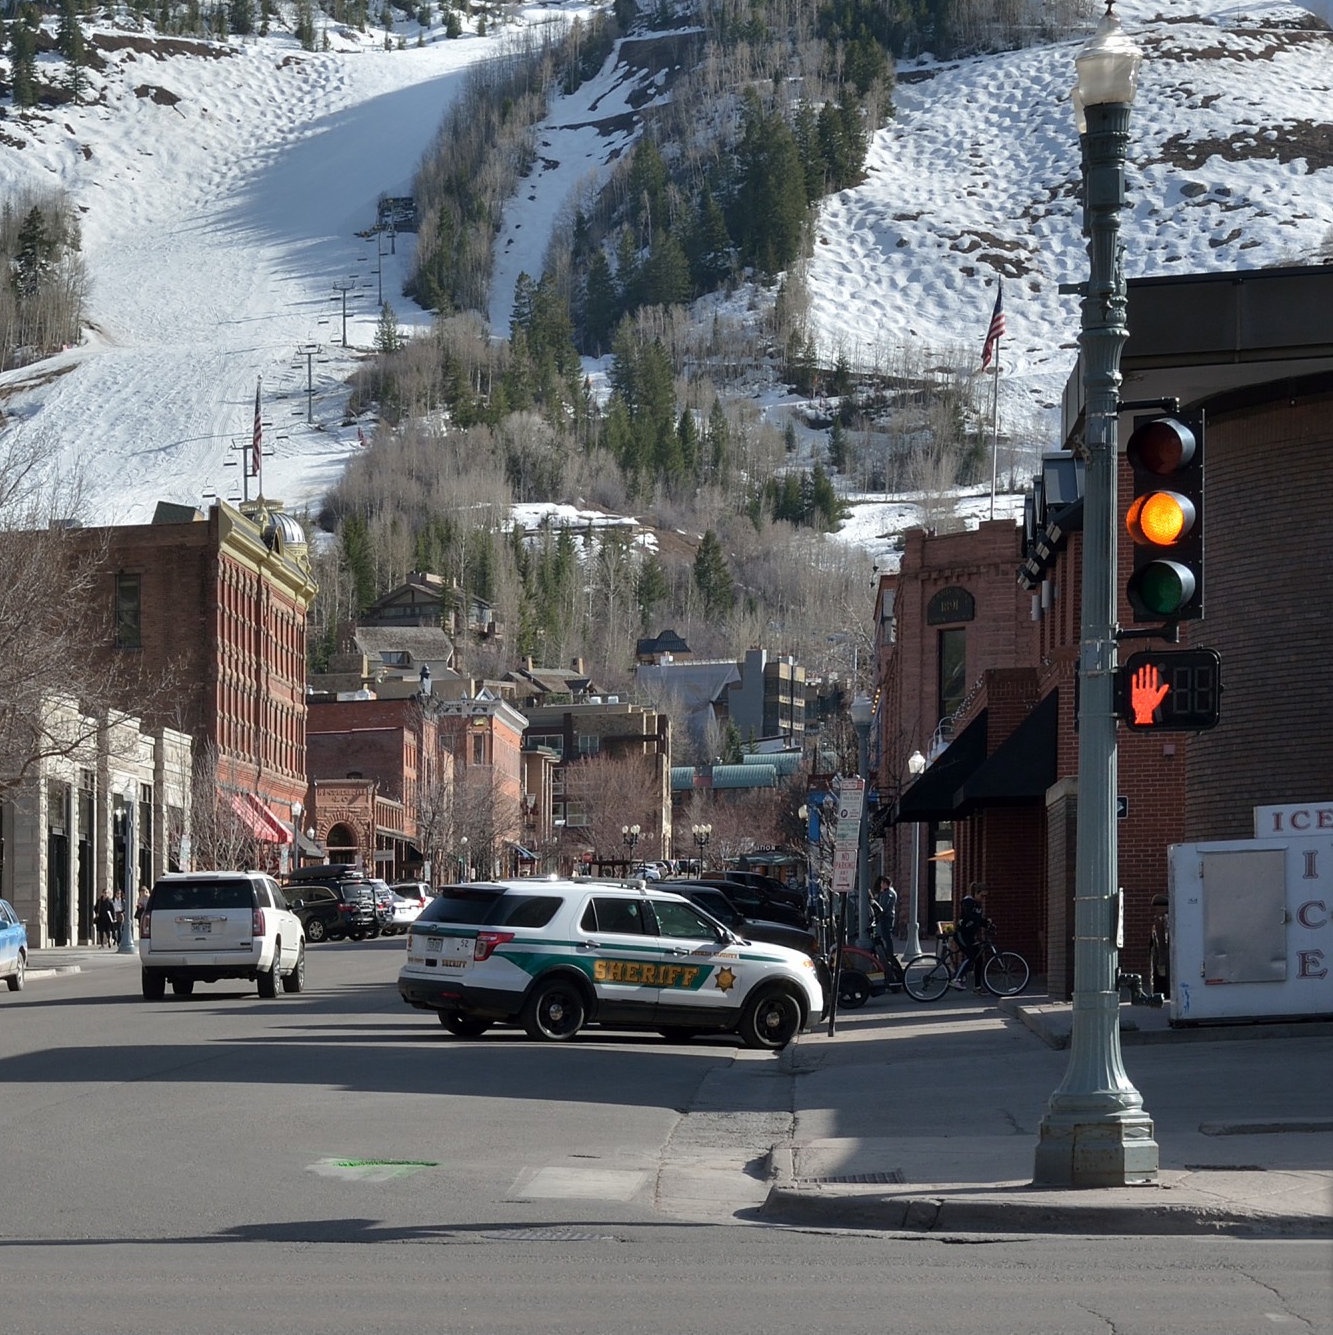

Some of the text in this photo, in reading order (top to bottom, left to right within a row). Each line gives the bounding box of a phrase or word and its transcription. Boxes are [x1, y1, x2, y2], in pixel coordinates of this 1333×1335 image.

[1272, 809, 1333, 832] ICE
[842, 852, 850, 861] NO
[460, 939, 469, 948] 52
[593, 959, 699, 987] SHERIFF
